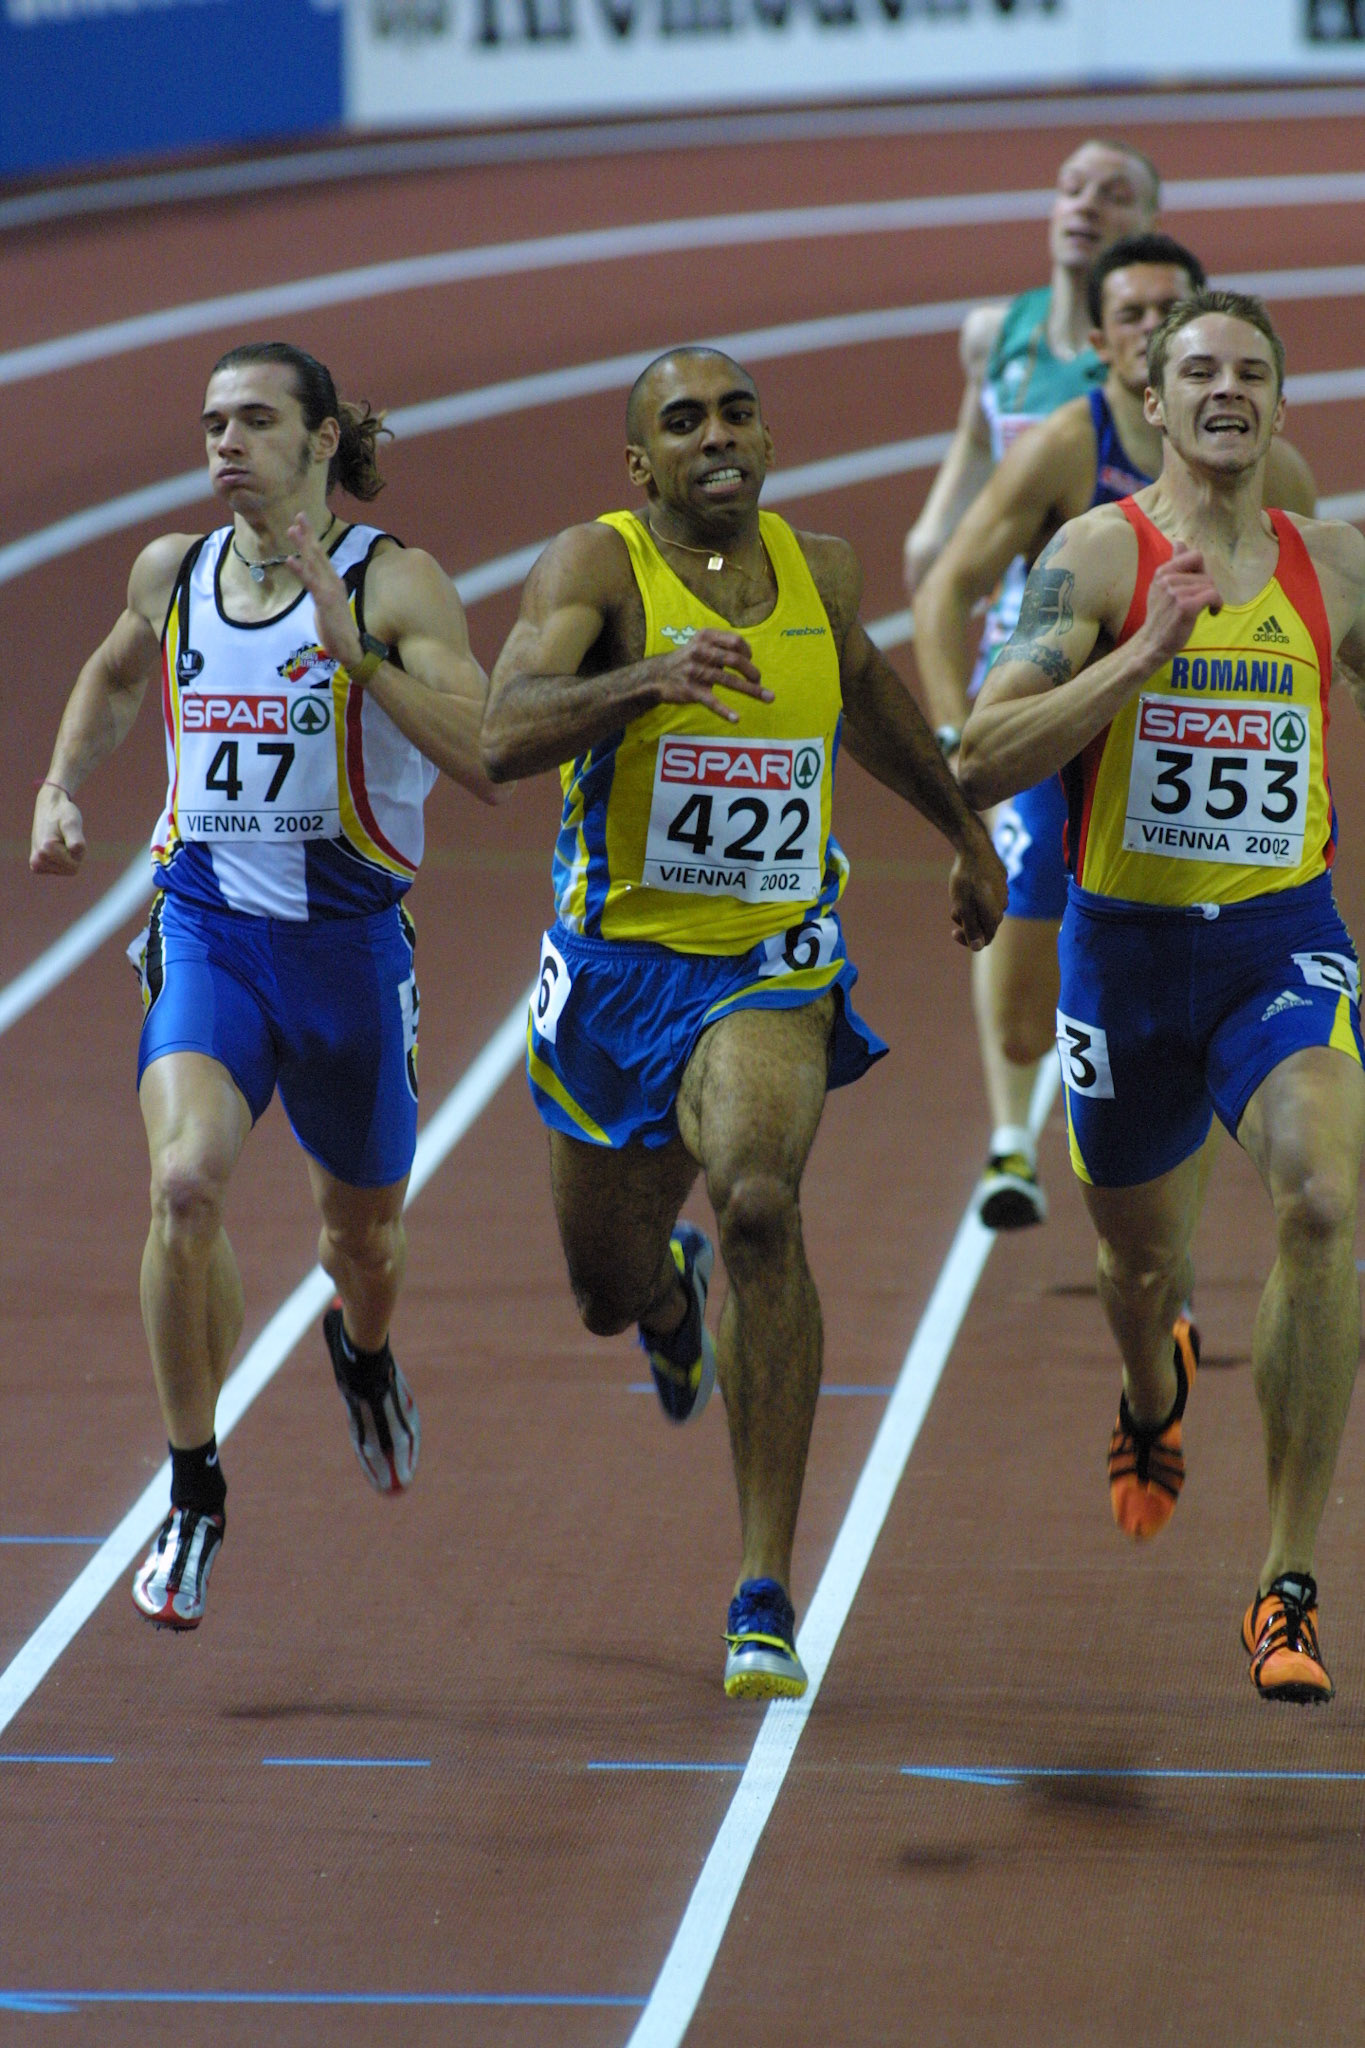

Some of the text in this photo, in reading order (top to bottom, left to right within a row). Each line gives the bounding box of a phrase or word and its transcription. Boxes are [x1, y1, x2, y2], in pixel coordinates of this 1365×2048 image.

[780, 627, 827, 637] reebok
[1253, 633, 1289, 644] adidas
[1171, 657, 1293, 696] ROMANIA
[183, 700, 284, 729] SPAR
[1143, 708, 1269, 745] SPAR
[206, 741, 296, 802] 47
[663, 747, 789, 784] SPAR
[1151, 749, 1298, 823] 353
[188, 815, 324, 832] VIENNA 2002
[667, 794, 810, 862] 422
[1142, 825, 1290, 855] VIENNA 2002
[660, 866, 800, 891] VIENNA 2002
[785, 921, 823, 970] 6
[537, 955, 559, 1018] 6
[1261, 999, 1313, 1022] adidas
[1065, 1024, 1096, 1088] 3
